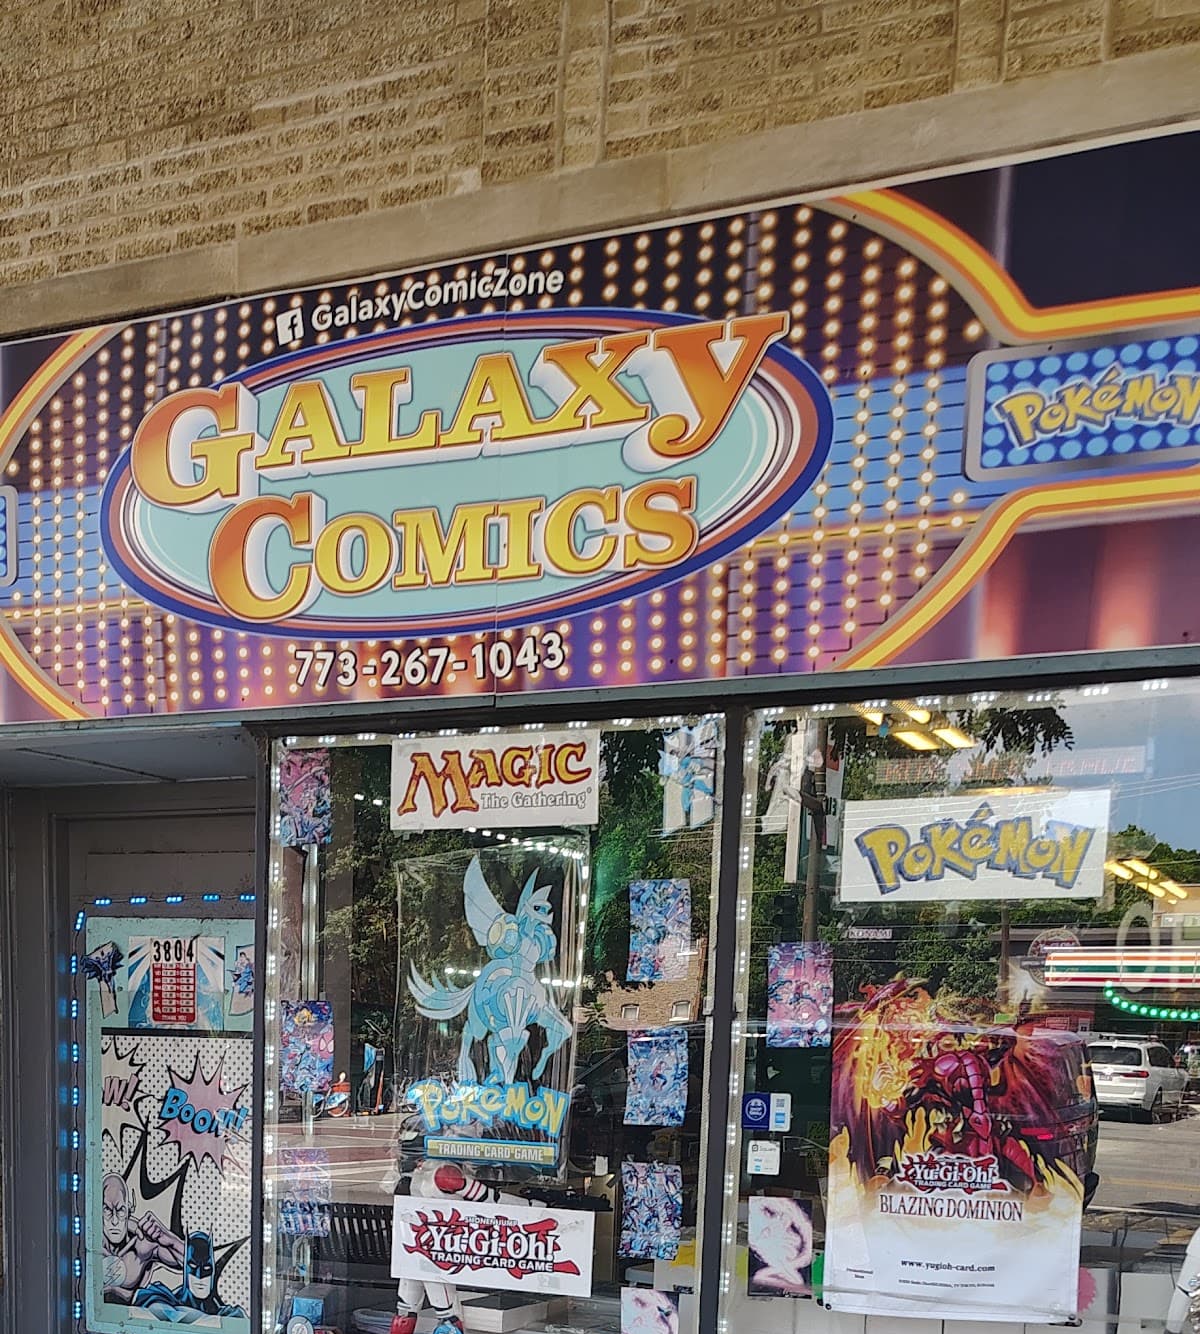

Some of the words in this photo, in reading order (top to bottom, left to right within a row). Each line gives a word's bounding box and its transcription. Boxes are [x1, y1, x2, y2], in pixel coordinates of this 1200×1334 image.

[311, 267, 565, 331] GalaxyComicZone
[131, 312, 790, 507] GALAXY
[209, 477, 699, 622] COMICS
[295, 632, 565, 687] 773-267-1043
[397, 741, 592, 818] MAGIC
[481, 793, 509, 810] The
[511, 790, 588, 810] Gathering
[153, 940, 194, 962] 3804
[438, 1143, 481, 1157] TRADING
[484, 1146, 510, 1159] CARD
[514, 1148, 544, 1161] GAME
[914, 1180, 947, 1188] TRADING
[880, 1194, 944, 1217] BLAZING
[946, 1199, 1024, 1221] DOMINION
[431, 1252, 480, 1265] TRADING
[483, 1257, 516, 1269] CARD
[518, 1261, 553, 1272] GAME
[901, 1259, 995, 1272] www.yugioh-card.com
